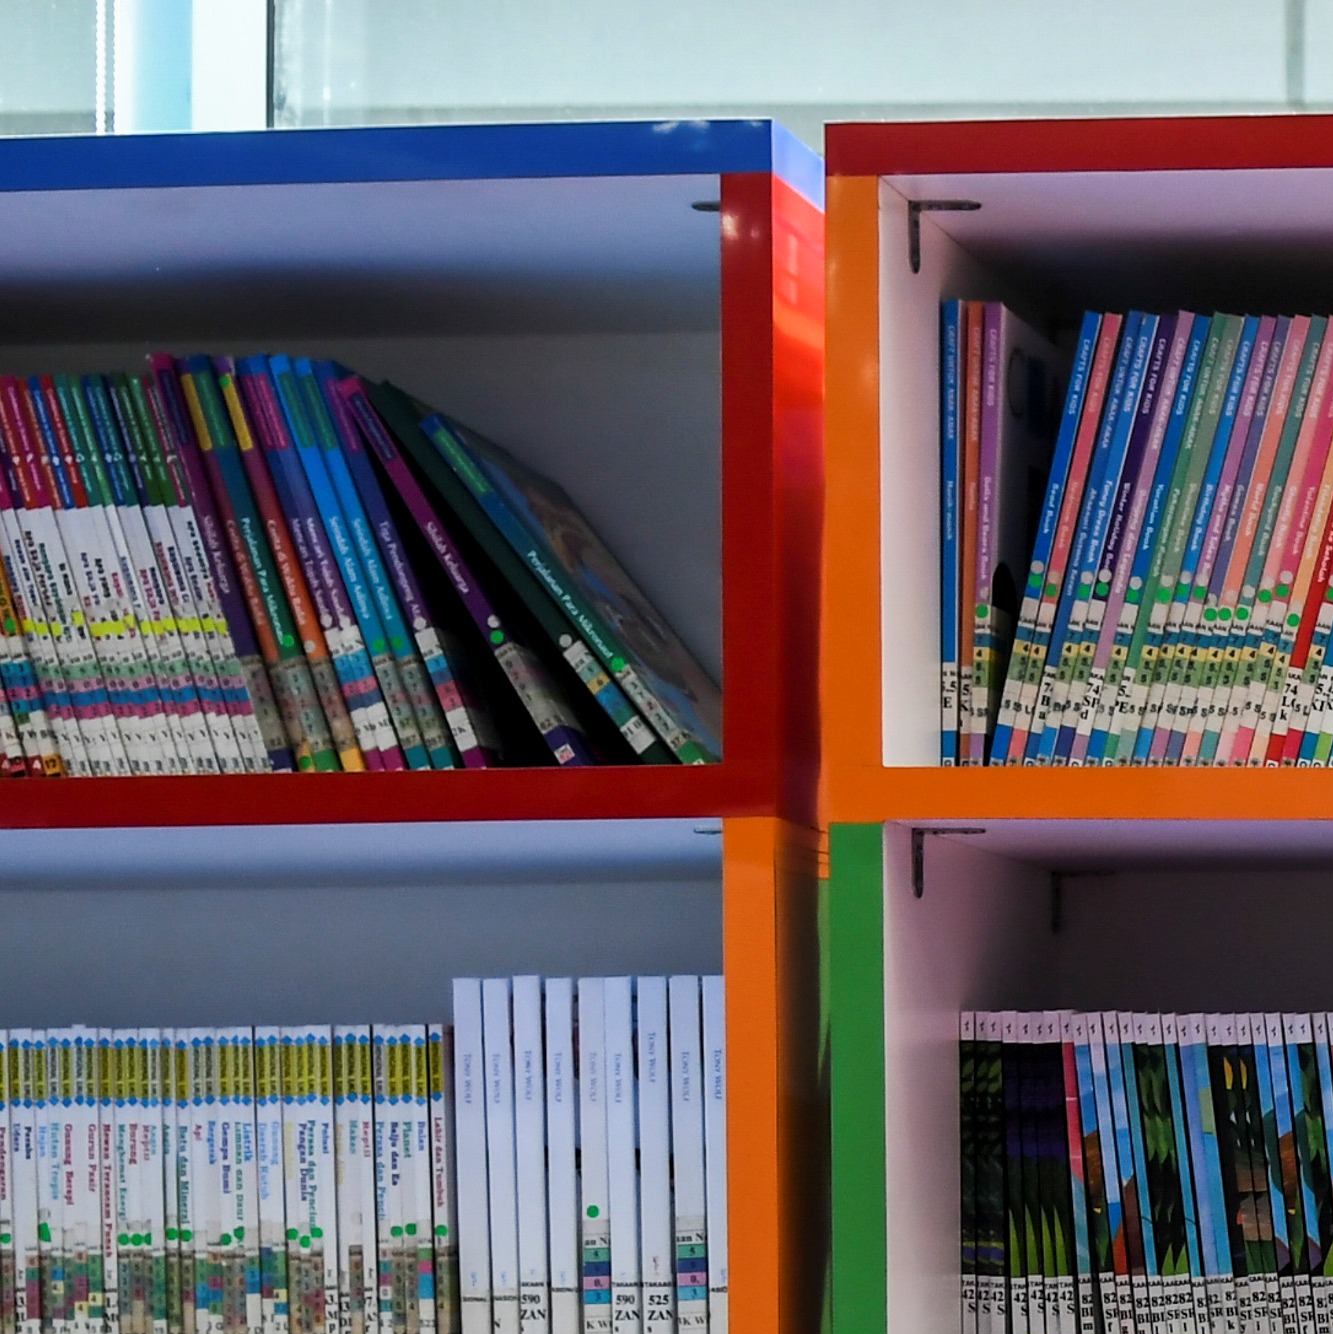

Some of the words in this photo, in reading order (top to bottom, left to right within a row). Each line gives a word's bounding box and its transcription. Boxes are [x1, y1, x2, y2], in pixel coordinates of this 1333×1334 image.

[616, 1295, 635, 1305] 590
[648, 1295, 669, 1306] 525
[614, 1309, 640, 1321] ZAN
[648, 1309, 673, 1321] ZAN
